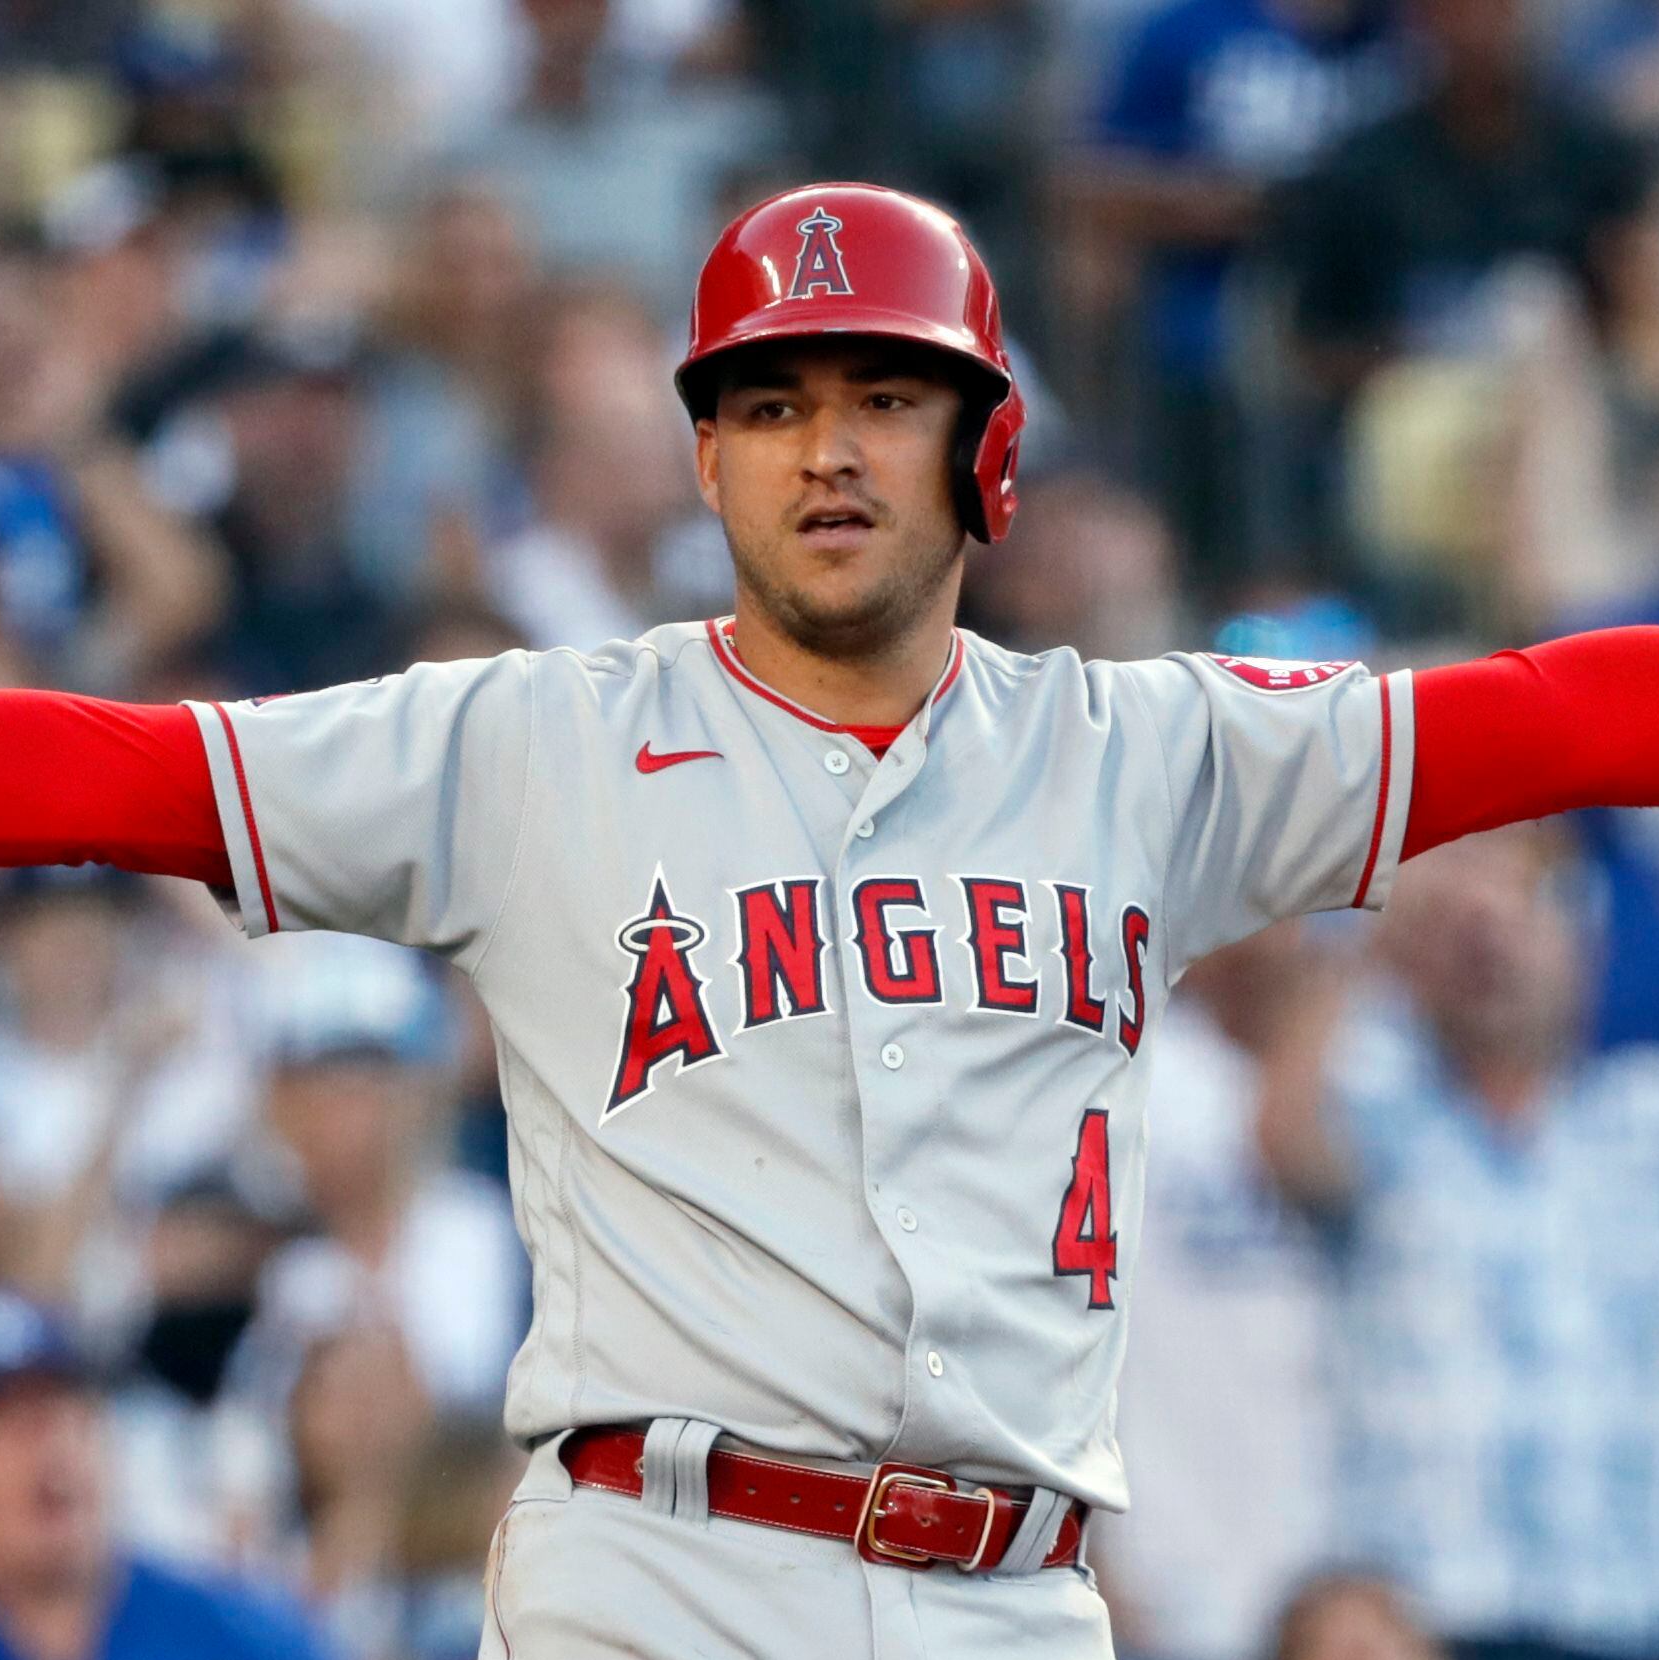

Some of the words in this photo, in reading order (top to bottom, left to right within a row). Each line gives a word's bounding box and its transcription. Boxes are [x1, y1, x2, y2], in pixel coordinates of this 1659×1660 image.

[786, 206, 855, 299] A
[598, 861, 1150, 1128] ANGELS
[1052, 1108, 1118, 1310] 4
